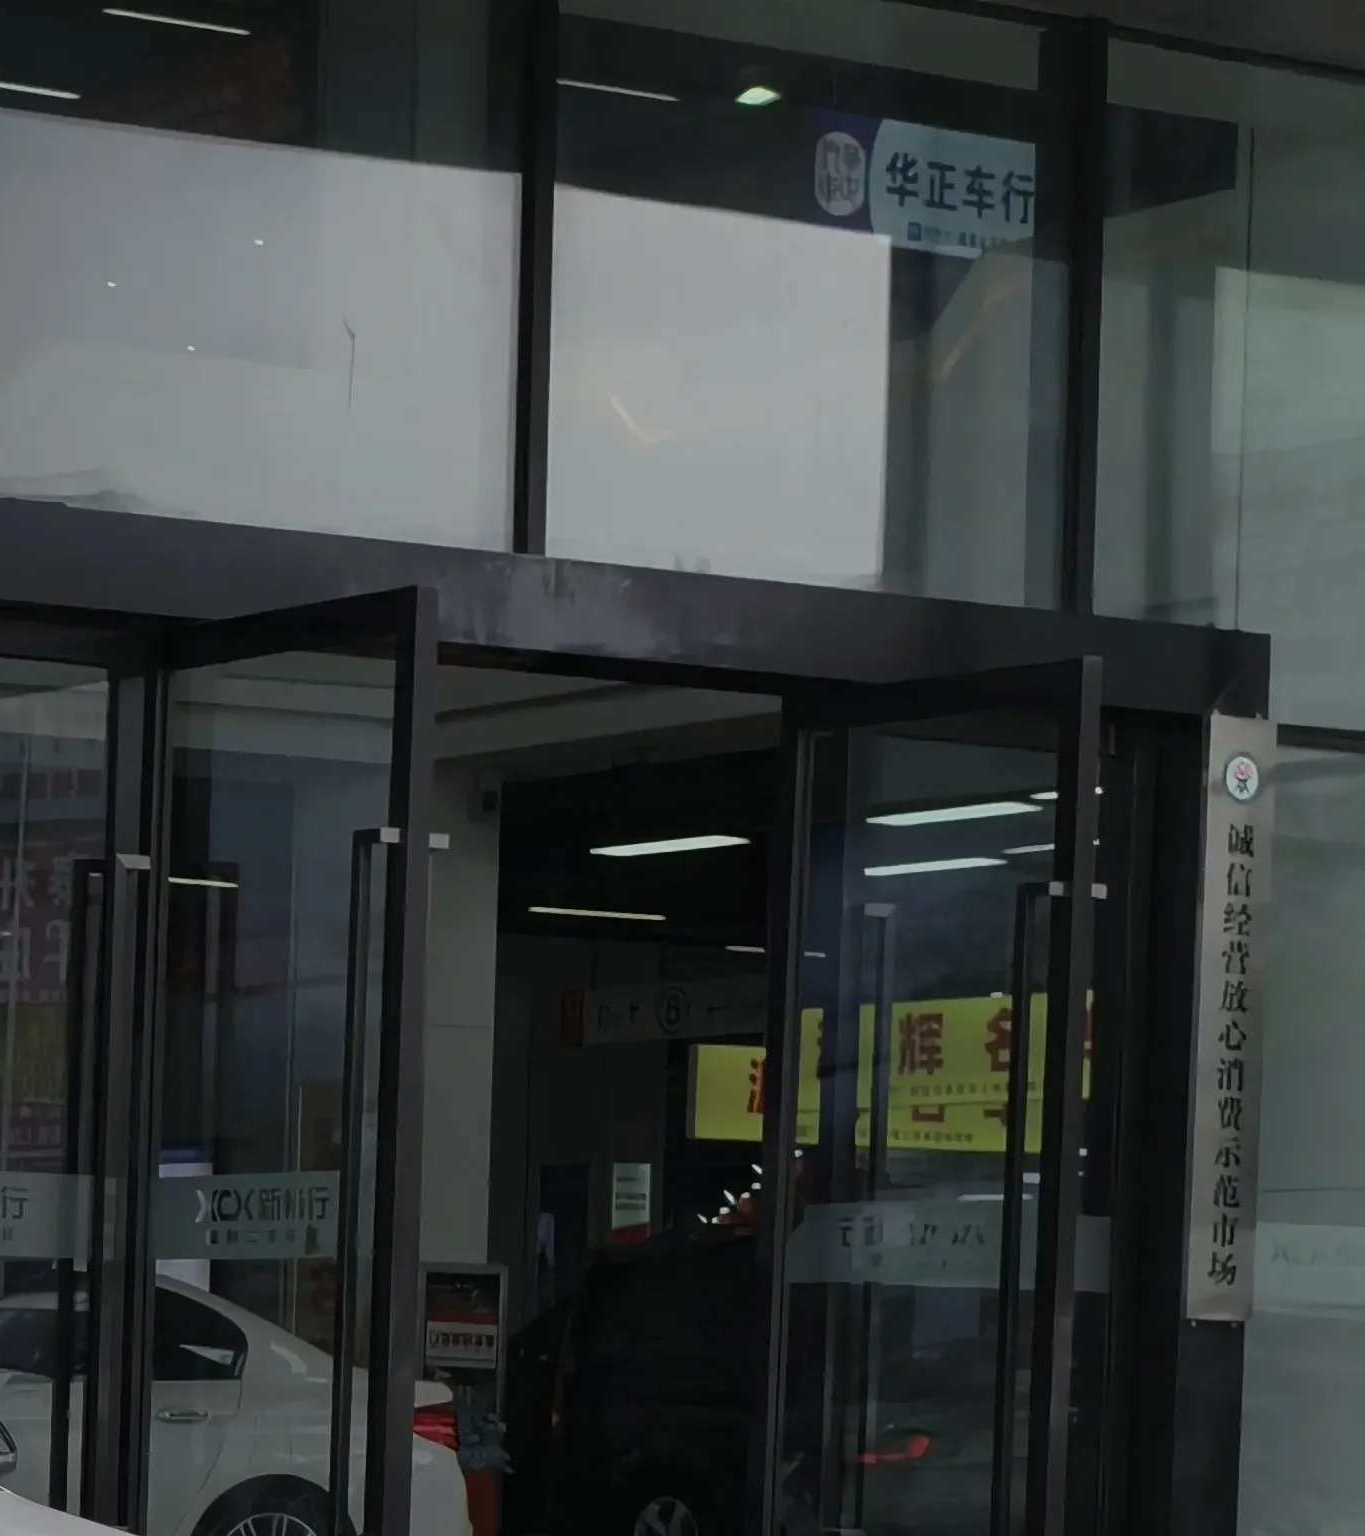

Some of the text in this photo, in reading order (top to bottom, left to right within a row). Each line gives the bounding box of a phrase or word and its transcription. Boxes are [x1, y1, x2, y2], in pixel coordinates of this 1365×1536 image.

[885, 151, 1035, 225] 华正车行
[1207, 822, 1256, 1287] 诚信经营放心消费示范市场
